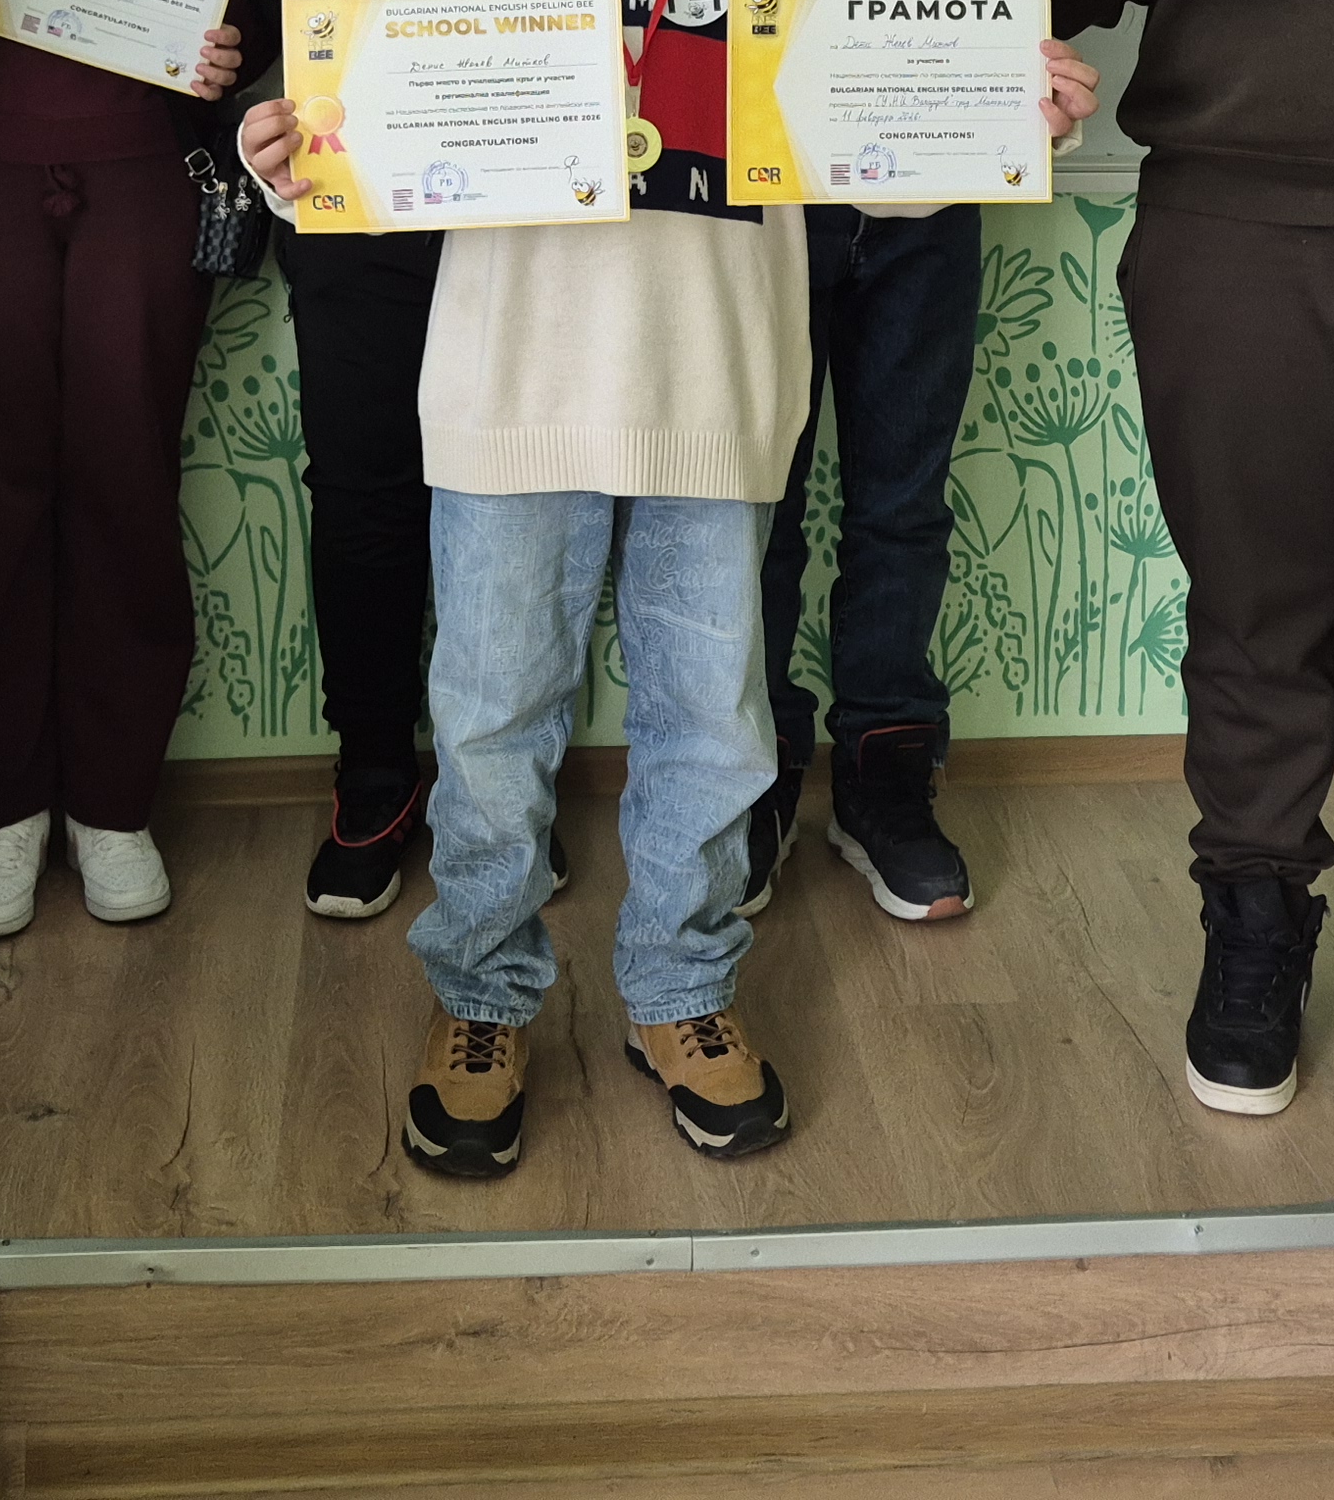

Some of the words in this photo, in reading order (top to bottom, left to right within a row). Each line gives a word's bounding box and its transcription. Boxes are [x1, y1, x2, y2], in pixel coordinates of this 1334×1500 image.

[386, 7, 438, 17] BULGARIAN
[441, 4, 487, 14] NATIONAL
[489, 3, 528, 12] ENGLISH
[530, 2, 574, 10] SPELLING
[577, 0, 594, 8] BEE
[847, 0, 1013, 20] ГРАМОТА
[385, 18, 487, 39] SCHOOL
[494, 14, 596, 35] WINNER
[752, 25, 776, 34] BEE
[309, 49, 334, 60] BEE
[386, 121, 434, 129] BULGARIAN
[437, 119, 479, 127] NATIONAL
[482, 117, 517, 125] ENGLISH
[879, 131, 974, 139] CONGRATULATIONS!
[440, 136, 538, 148] CONGRATULATIONS!
